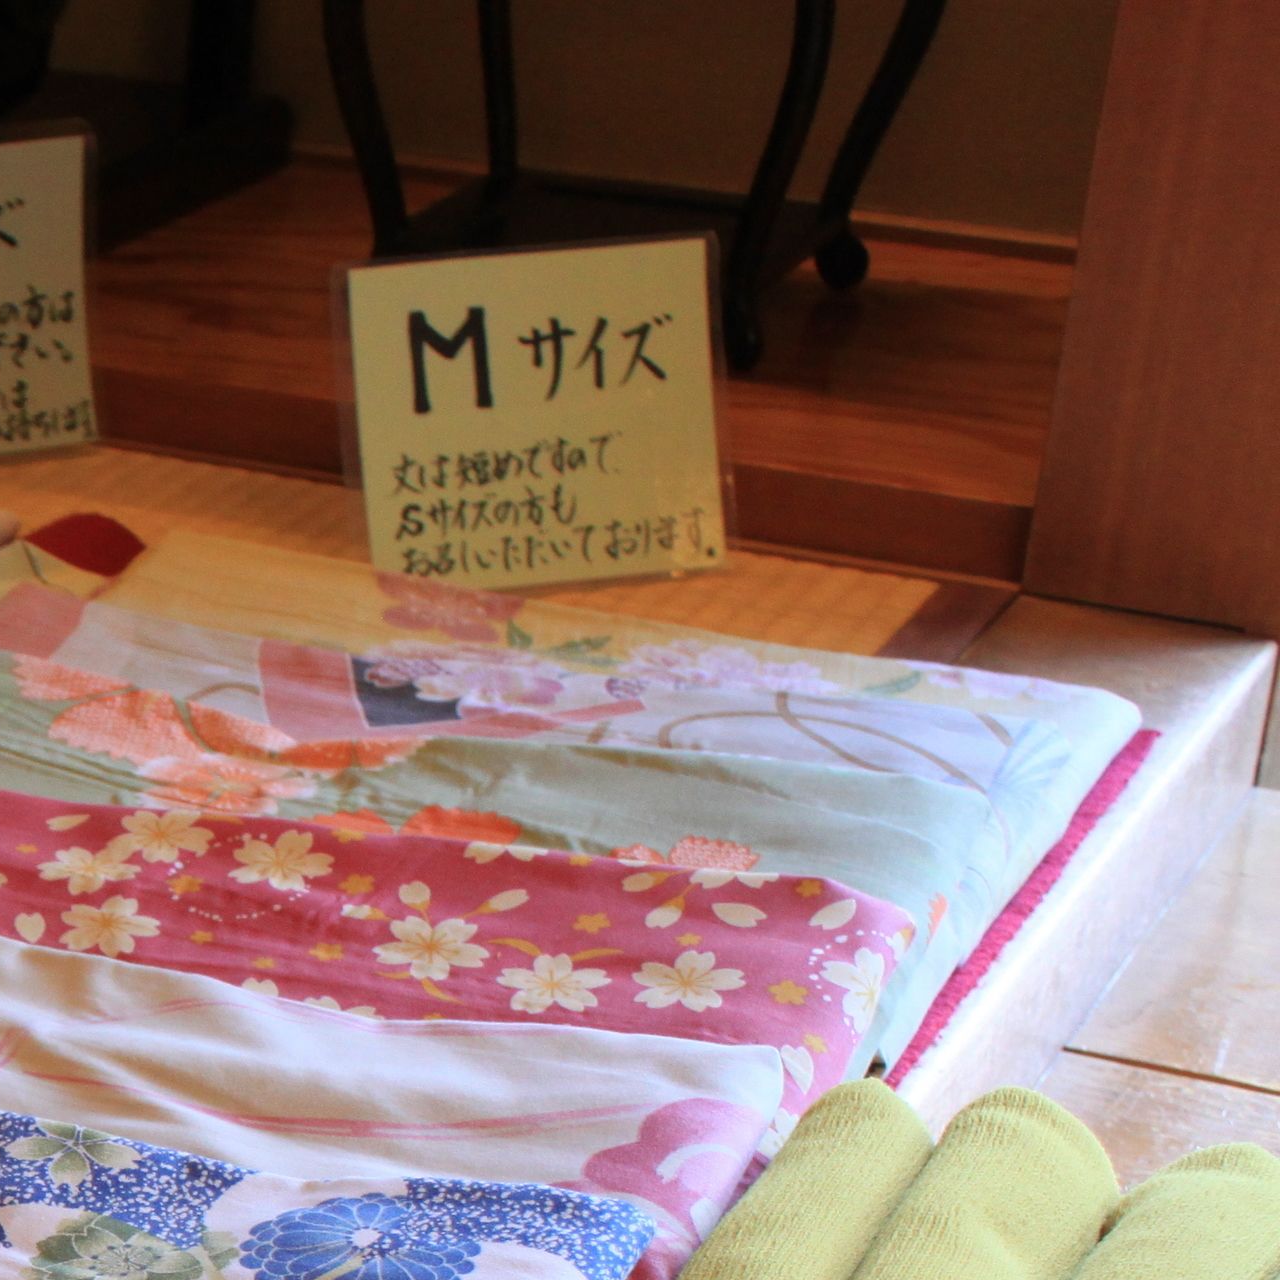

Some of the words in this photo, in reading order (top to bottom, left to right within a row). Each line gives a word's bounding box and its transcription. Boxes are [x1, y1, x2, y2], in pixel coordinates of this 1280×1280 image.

[396, 481, 577, 541] Sサイズの方も
